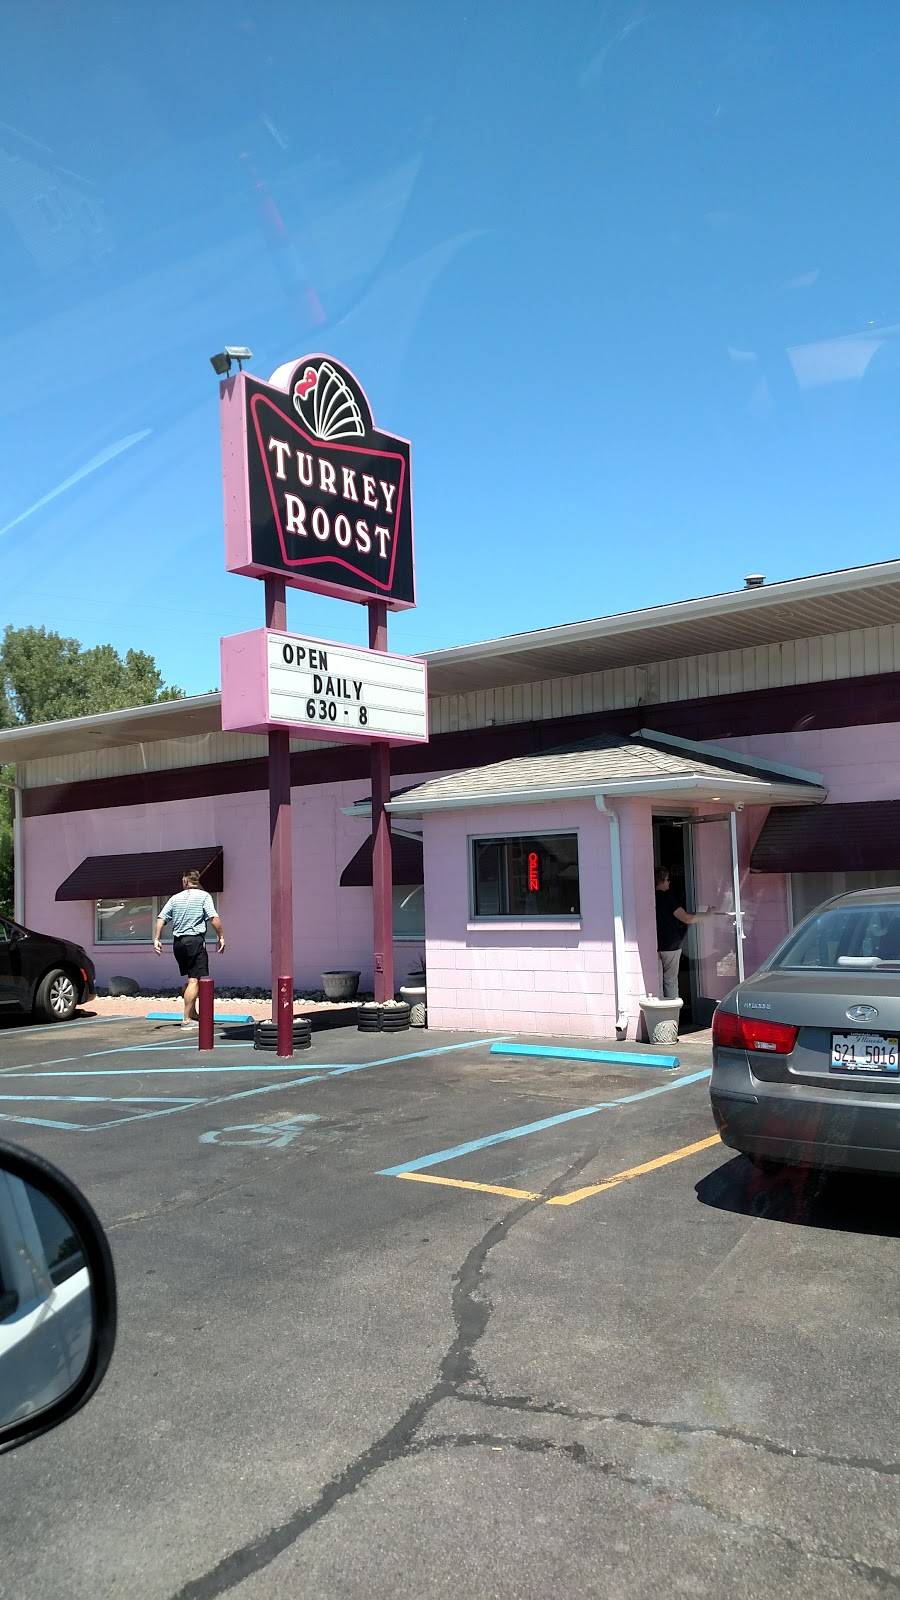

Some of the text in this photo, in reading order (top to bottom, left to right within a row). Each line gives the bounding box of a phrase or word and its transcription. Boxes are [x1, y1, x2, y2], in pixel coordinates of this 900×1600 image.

[268, 436, 396, 515] TURKEY
[284, 491, 391, 559] ROOST
[282, 643, 328, 671] OPEN
[313, 674, 363, 700] DAILY
[306, 698, 337, 721] 630
[359, 705, 368, 725] 8
[528, 852, 539, 891] OPEN
[834, 1043, 896, 1066] S21 5016
